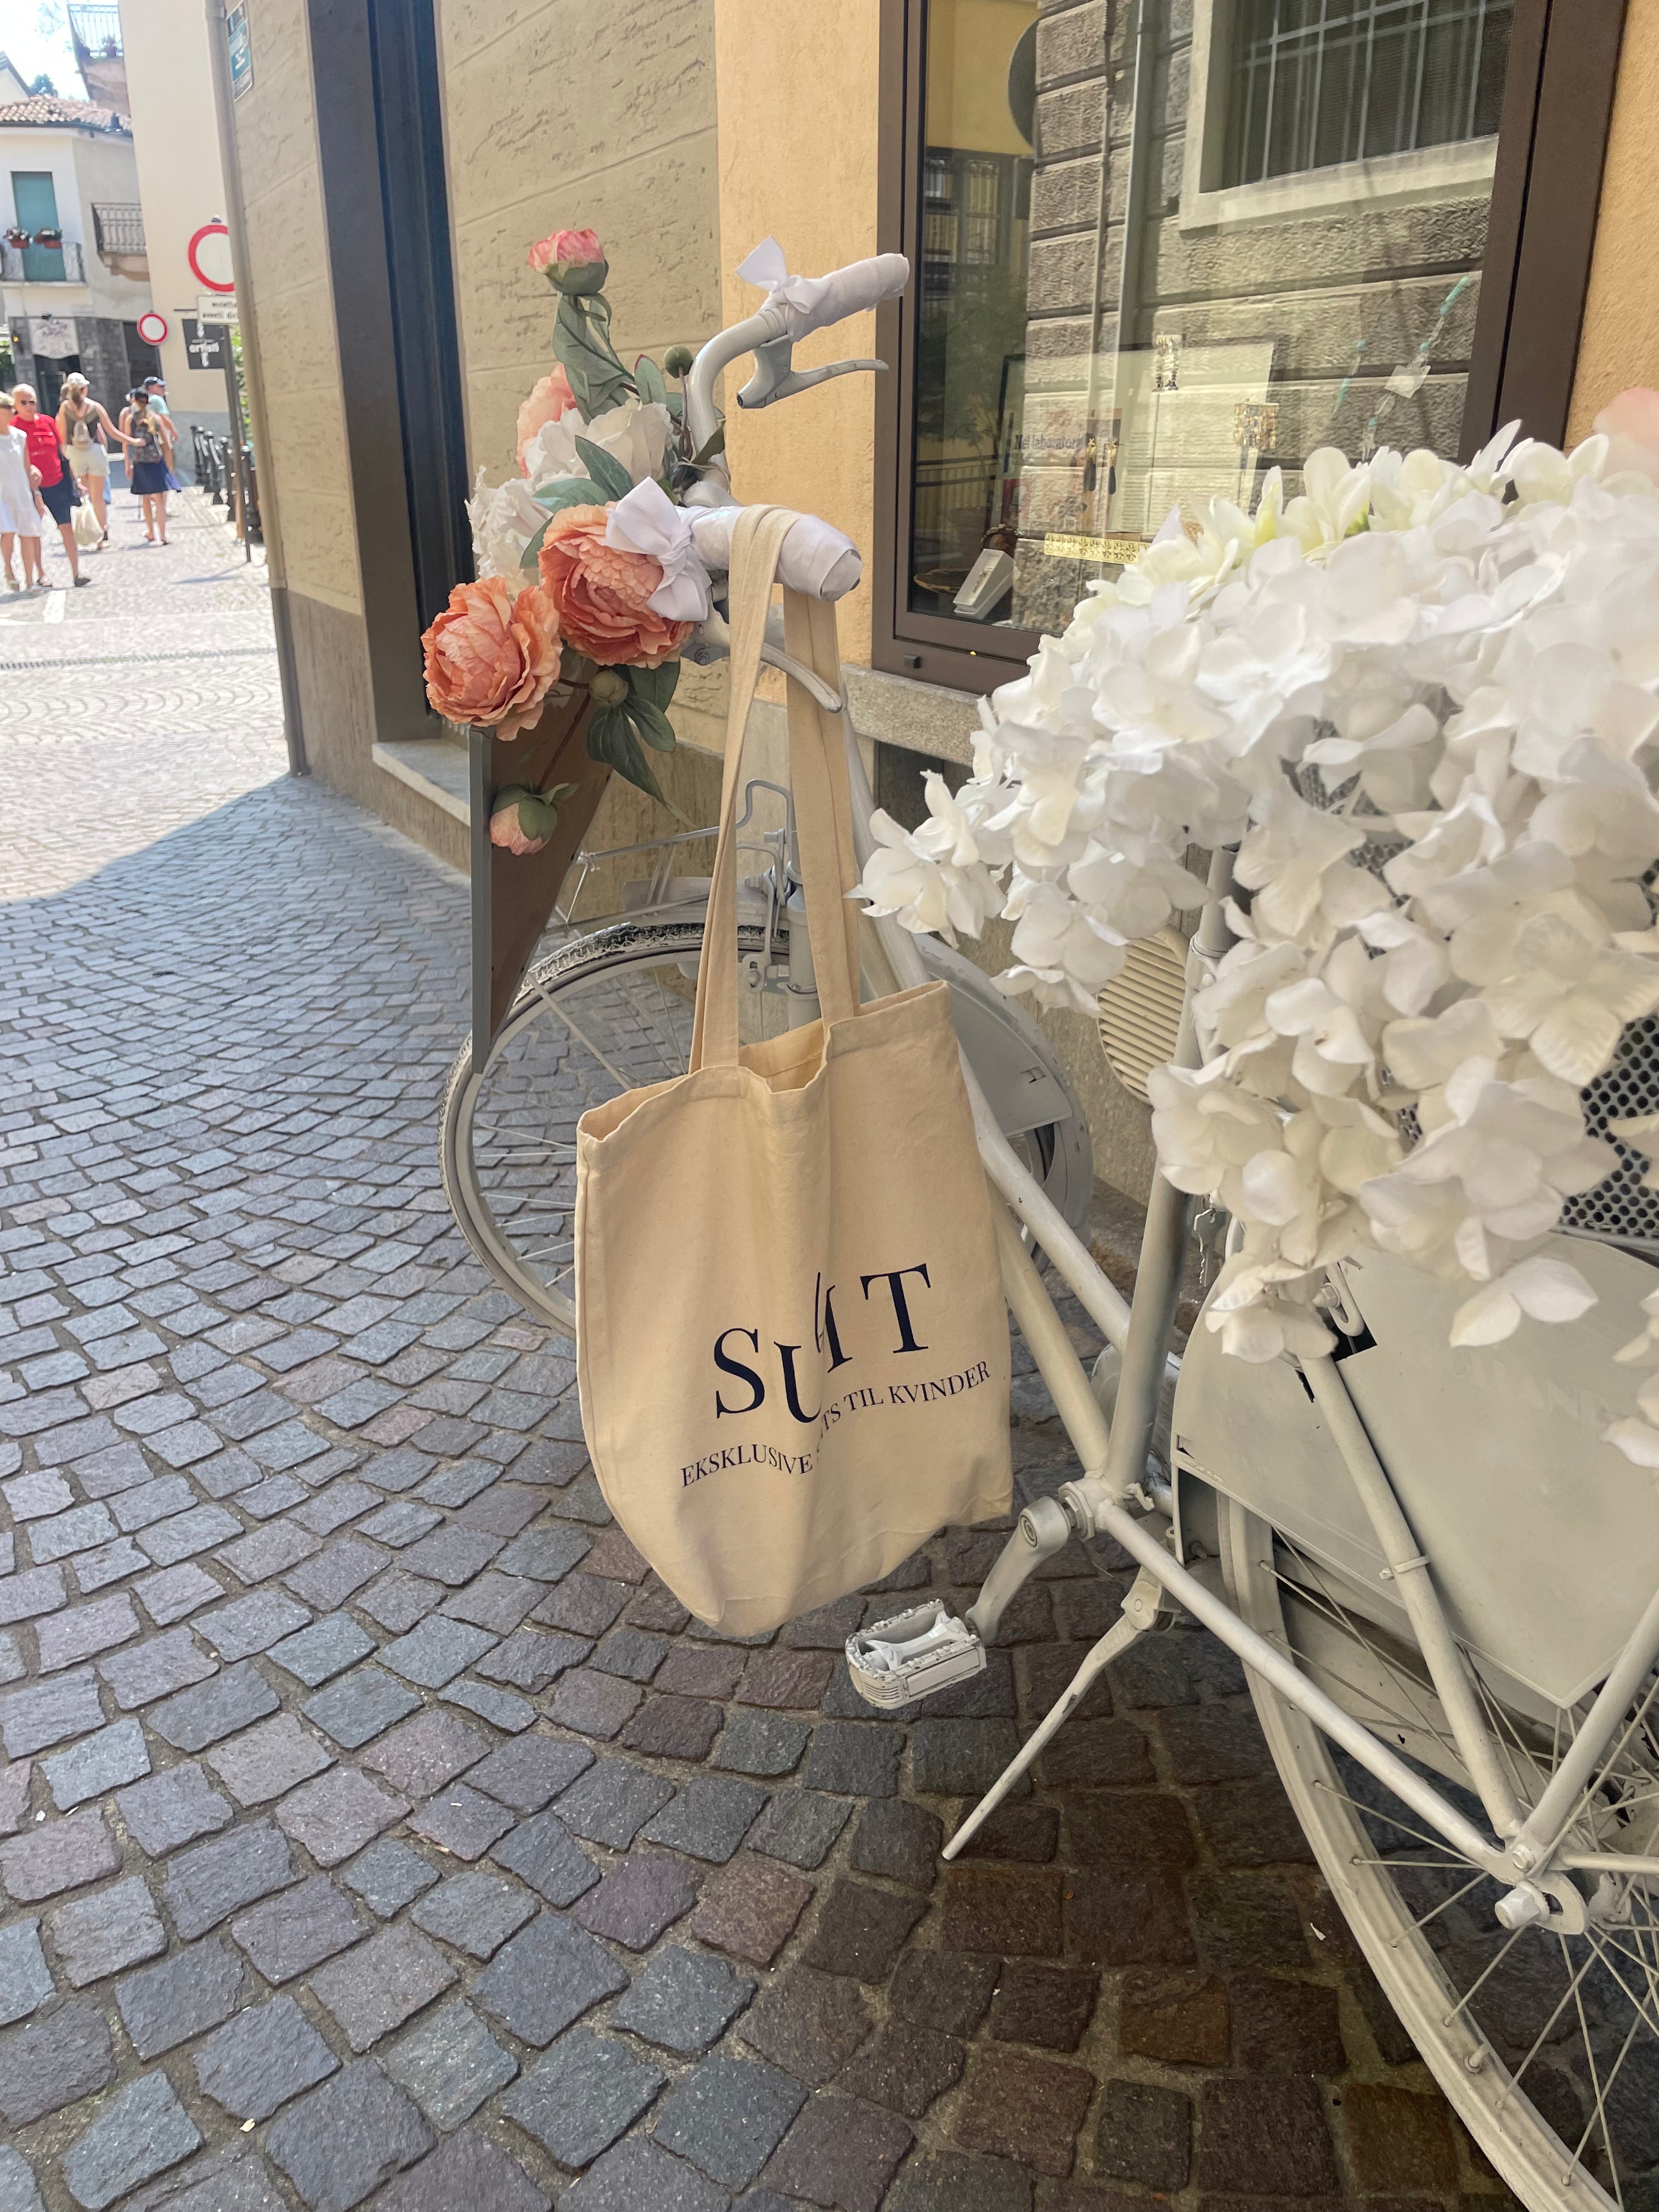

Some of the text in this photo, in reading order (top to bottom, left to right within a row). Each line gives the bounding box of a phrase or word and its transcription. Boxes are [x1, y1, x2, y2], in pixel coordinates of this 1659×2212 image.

[714, 1262, 931, 1424] SUIT
[680, 1443, 813, 1488] EKSKLUSIVE
[843, 1387, 884, 1412] TIL
[887, 1361, 991, 1404] KVINDER
